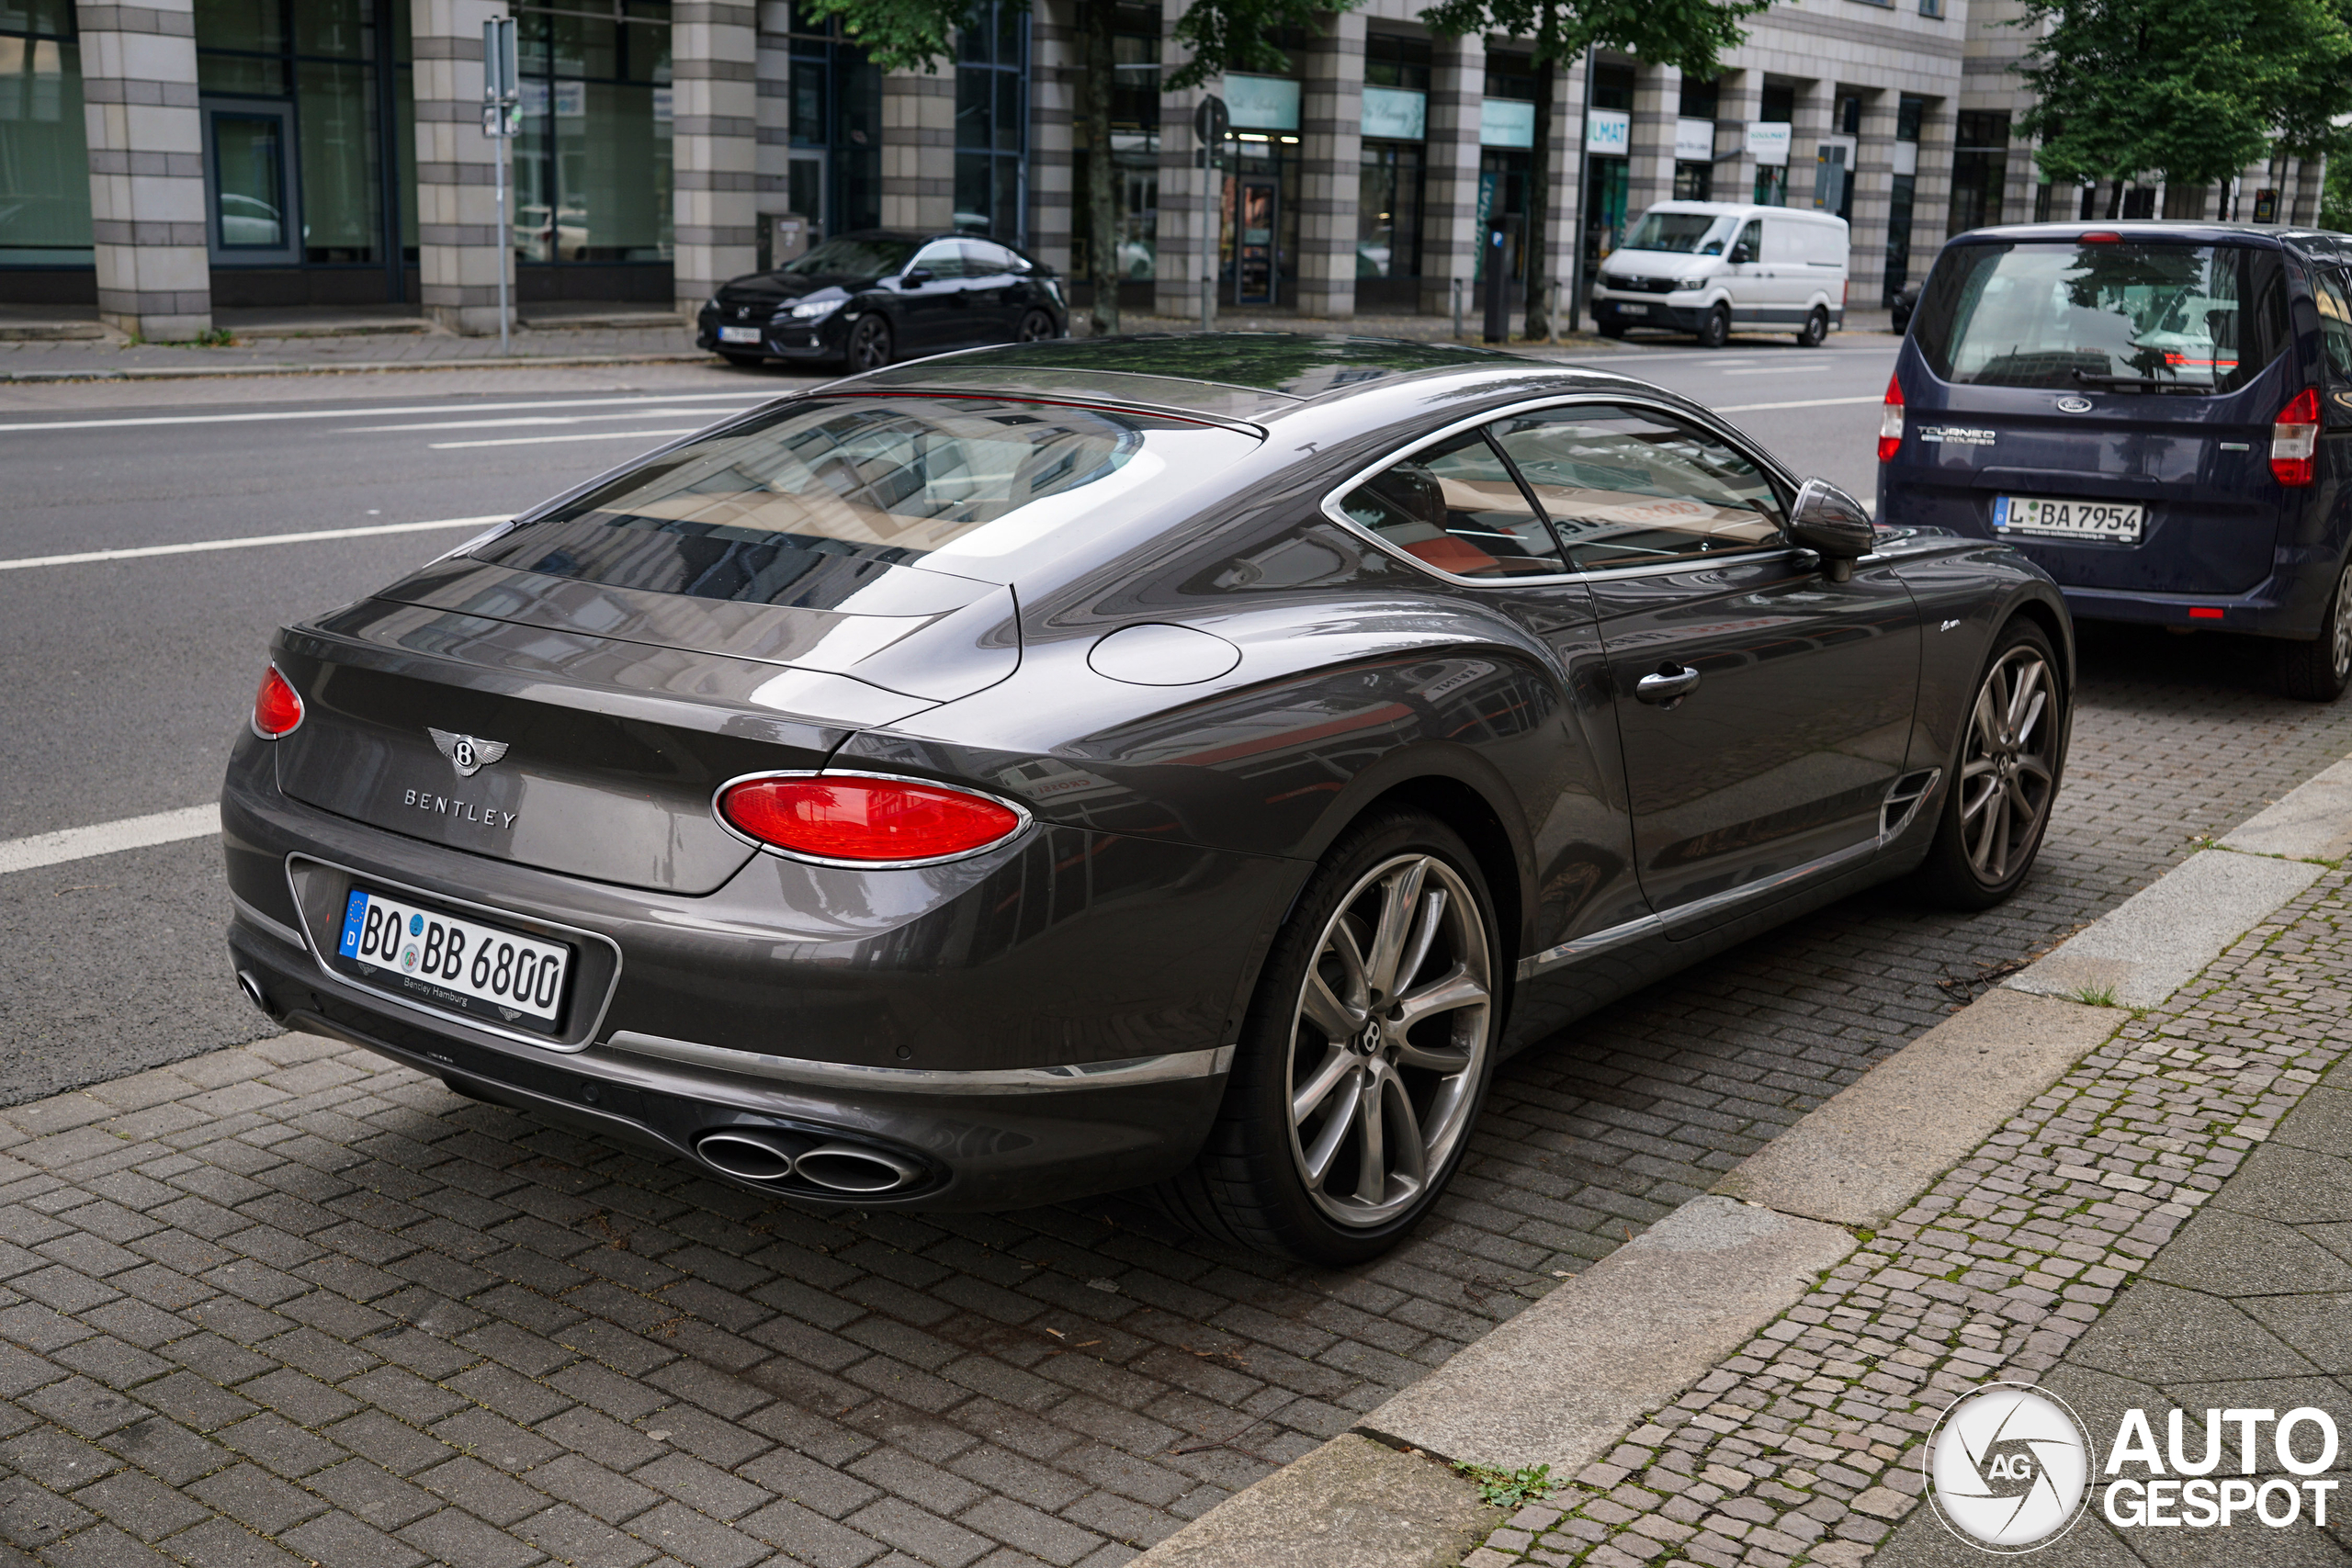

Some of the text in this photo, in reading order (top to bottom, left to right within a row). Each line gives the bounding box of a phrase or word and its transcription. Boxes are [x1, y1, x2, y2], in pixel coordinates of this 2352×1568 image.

[1917, 425, 1996, 439] TOURNEO
[2009, 501, 2023, 524] L
[2041, 503, 2070, 526] BA
[2078, 506, 2137, 532] 7954
[456, 742, 472, 766] B
[404, 788, 516, 829] BENTLEY
[346, 904, 560, 1009] D BO BB 6800
[404, 977, 469, 1008] Bentley Hamburg
[1363, 1021, 1381, 1053] B
